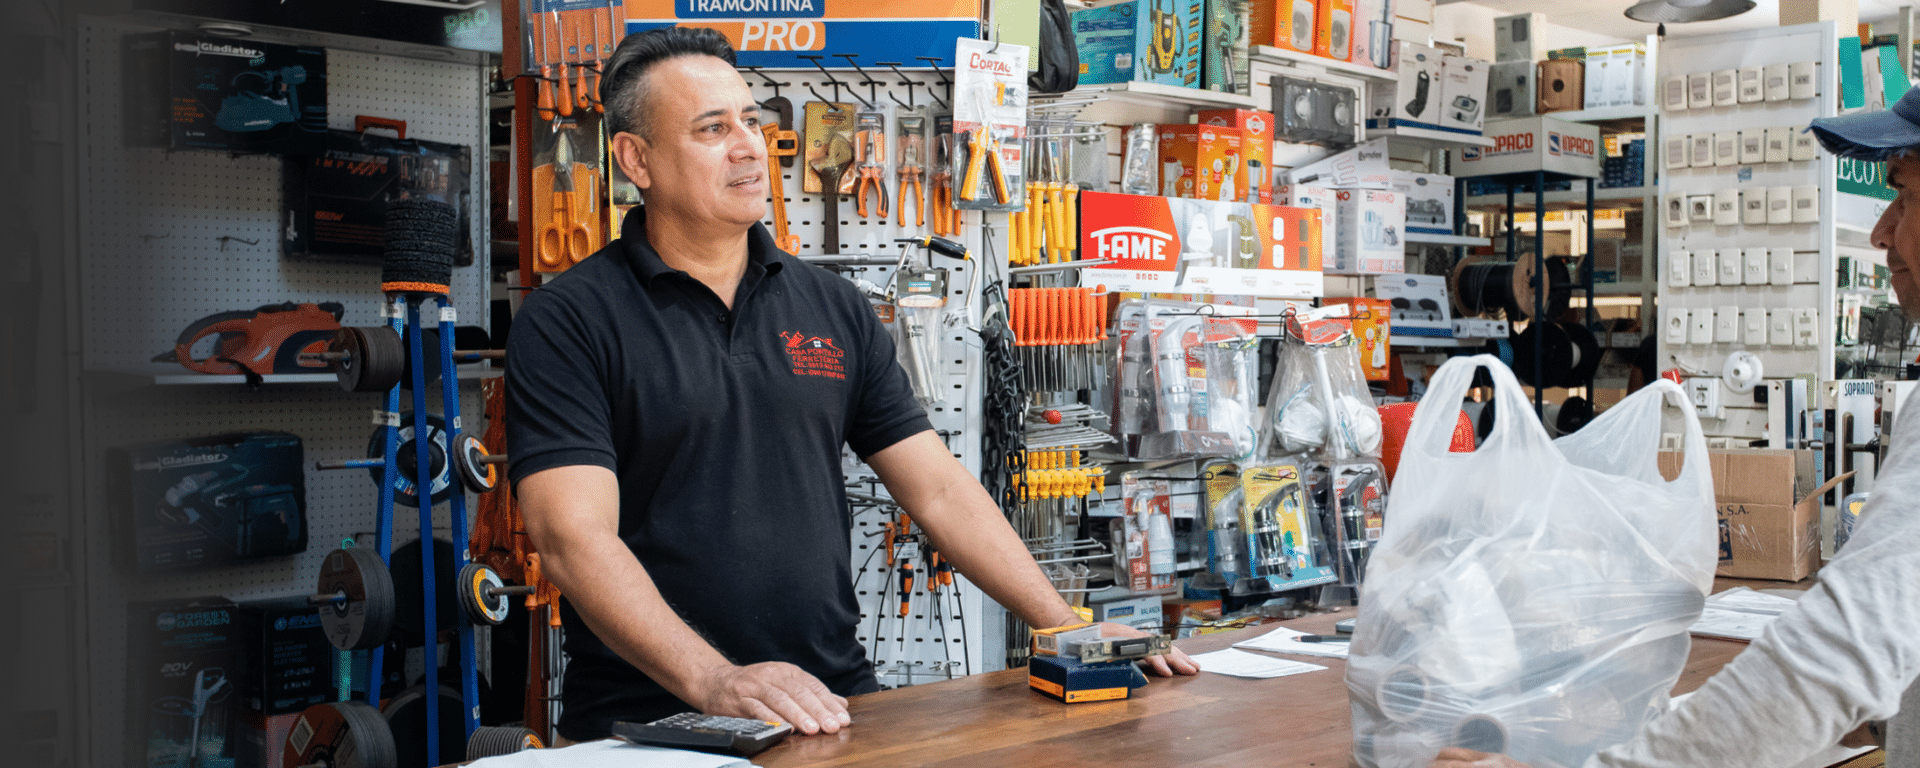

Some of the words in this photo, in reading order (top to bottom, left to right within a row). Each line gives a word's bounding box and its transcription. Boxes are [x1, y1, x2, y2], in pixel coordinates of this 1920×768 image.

[689, 0, 814, 12] TRAMONTINA
[740, 21, 816, 51] PRO
[200, 42, 258, 55] Gladiator
[1562, 135, 1594, 156] INPACO
[1091, 227, 1172, 261] FAME
[807, 348, 844, 358] PORTILLO
[793, 355, 840, 364] FERRETERIA
[1844, 381, 1875, 396] SOPRANO
[162, 453, 220, 466] Gladiator
[1726, 505, 1750, 516] S.A.
[177, 618, 230, 628] GARDEN
[288, 613, 321, 623] ENE
[160, 661, 194, 673] 20V
